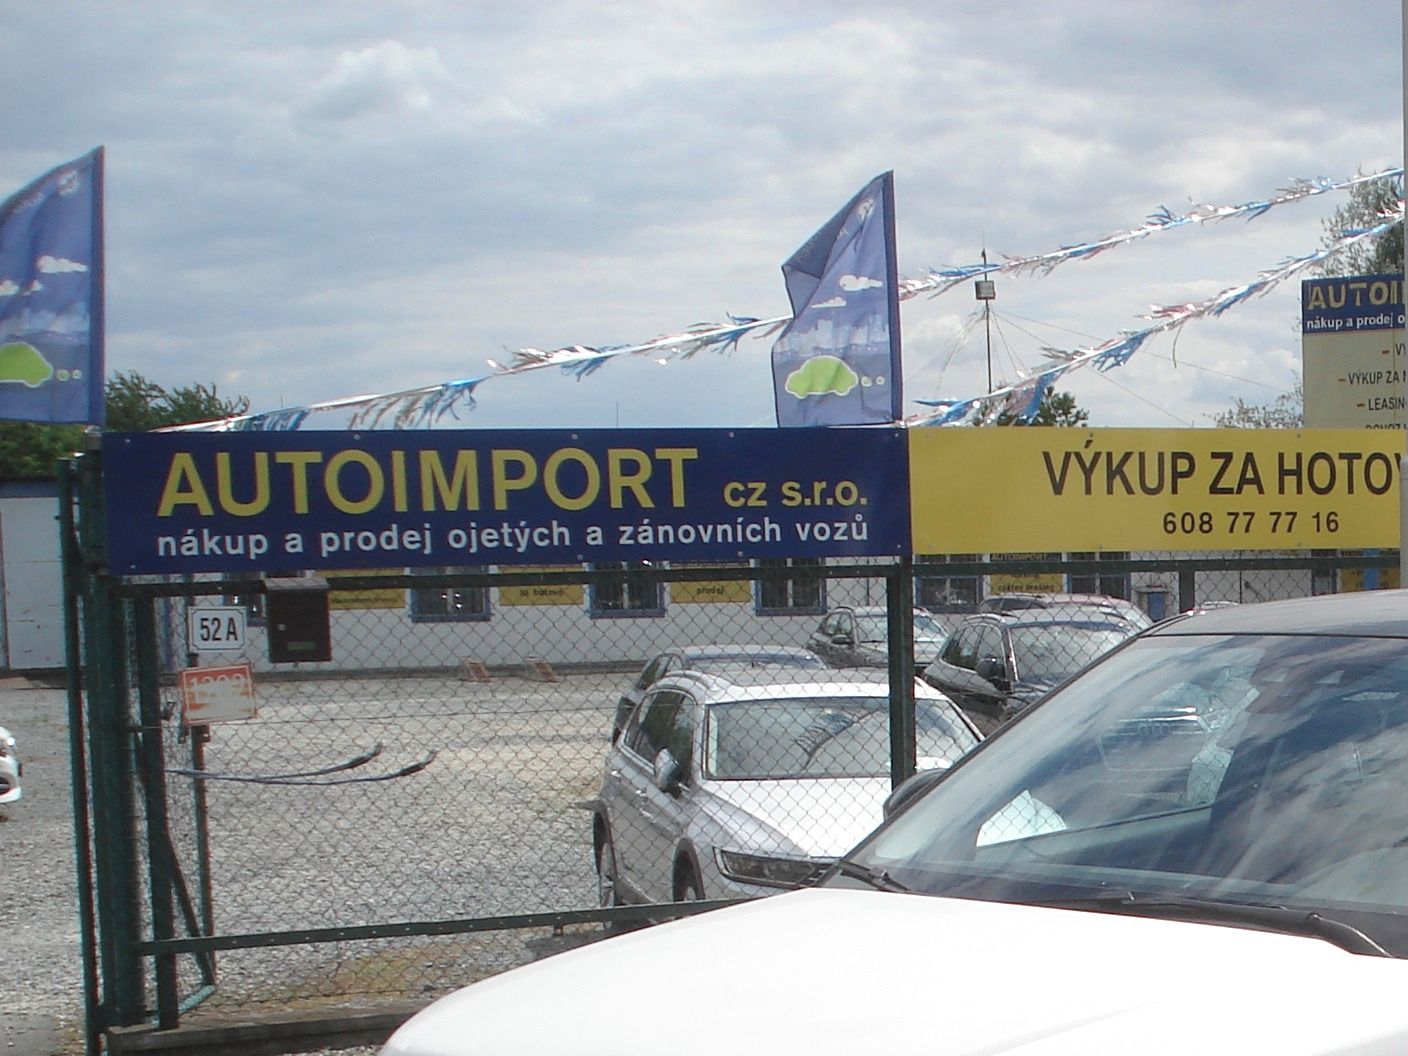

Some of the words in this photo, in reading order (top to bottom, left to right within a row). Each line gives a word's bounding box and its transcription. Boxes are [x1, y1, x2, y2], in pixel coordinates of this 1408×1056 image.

[1306, 315, 1343, 330] nákup
[1346, 319, 1354, 328] a
[1356, 312, 1394, 329] prodej
[1386, 370, 1400, 384] ZA
[1368, 397, 1407, 411] LEASIN
[1042, 437, 1196, 495] VÝKUP
[1209, 451, 1265, 495] ZA
[157, 447, 698, 517] AUTOIMPORT
[723, 480, 768, 508] cz
[781, 480, 868, 507] s.r.o.
[1163, 511, 1213, 534] 608
[1226, 511, 1256, 534] 77
[1269, 511, 1298, 534] 77
[1312, 511, 1339, 534] 16
[158, 529, 269, 560] nákup
[284, 532, 304, 553] a
[321, 523, 432, 558] prodej
[448, 520, 571, 553] ojetých
[586, 526, 603, 546] a
[618, 517, 780, 546] zánovních
[795, 513, 868, 542] vozů
[200, 617, 222, 642] 52
[225, 616, 239, 642] A
